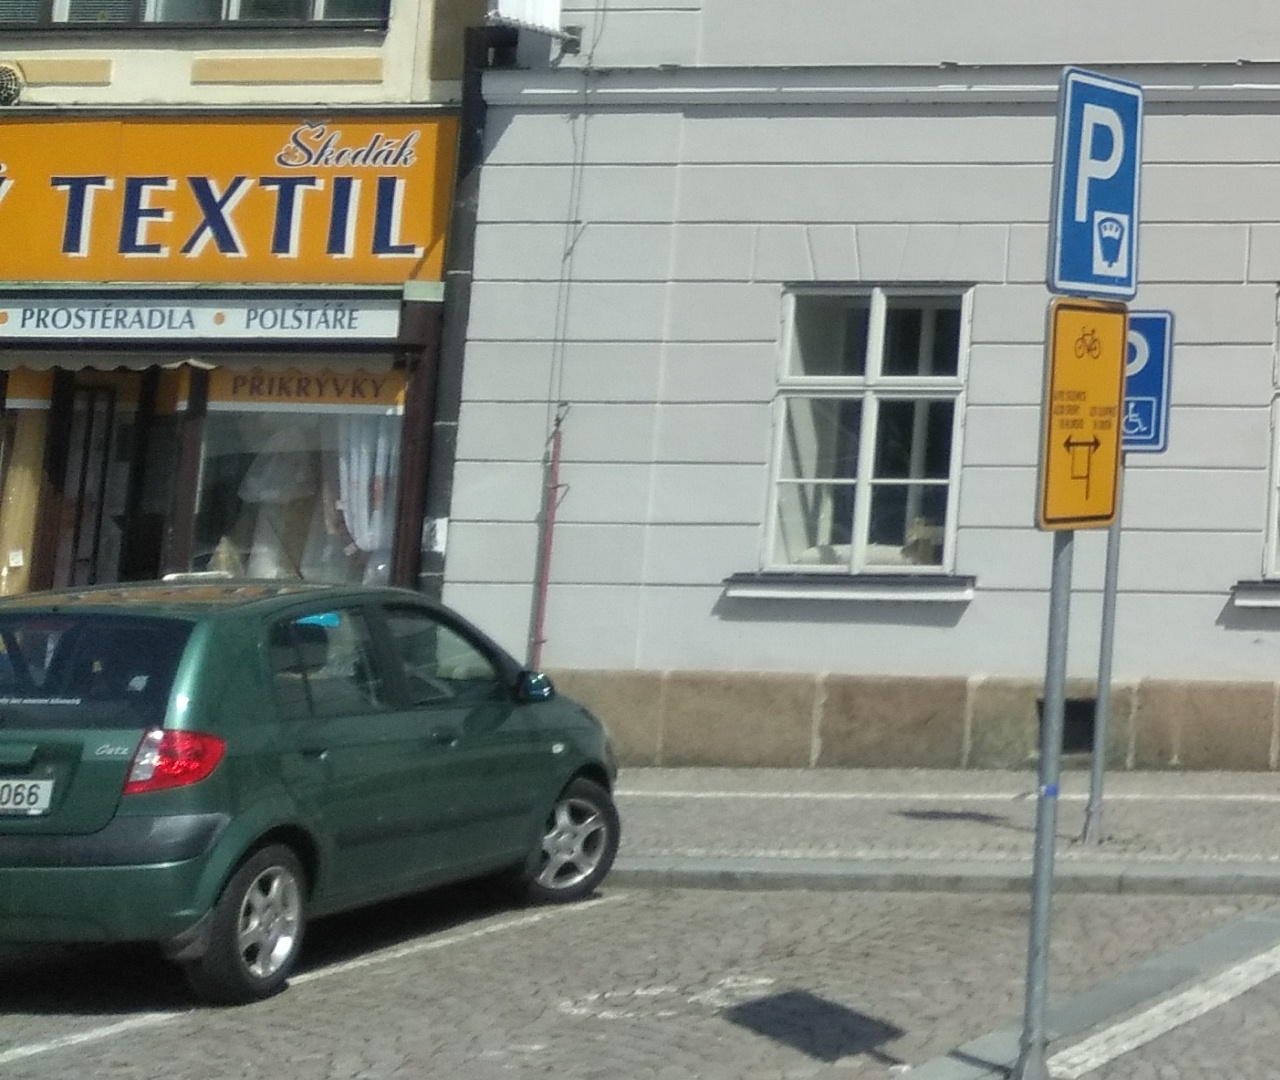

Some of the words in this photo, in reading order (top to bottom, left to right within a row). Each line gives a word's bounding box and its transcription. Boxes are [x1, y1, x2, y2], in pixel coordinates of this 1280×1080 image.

[276, 119, 421, 168] Škodák
[1075, 103, 1126, 223] P
[50, 174, 425, 259] TEXTIL
[20, 302, 196, 331] PROSTĚRADLA
[244, 302, 360, 331] POLŠTÁŘE
[95, 744, 129, 755] Getz
[0, 783, 41, 806] 066
